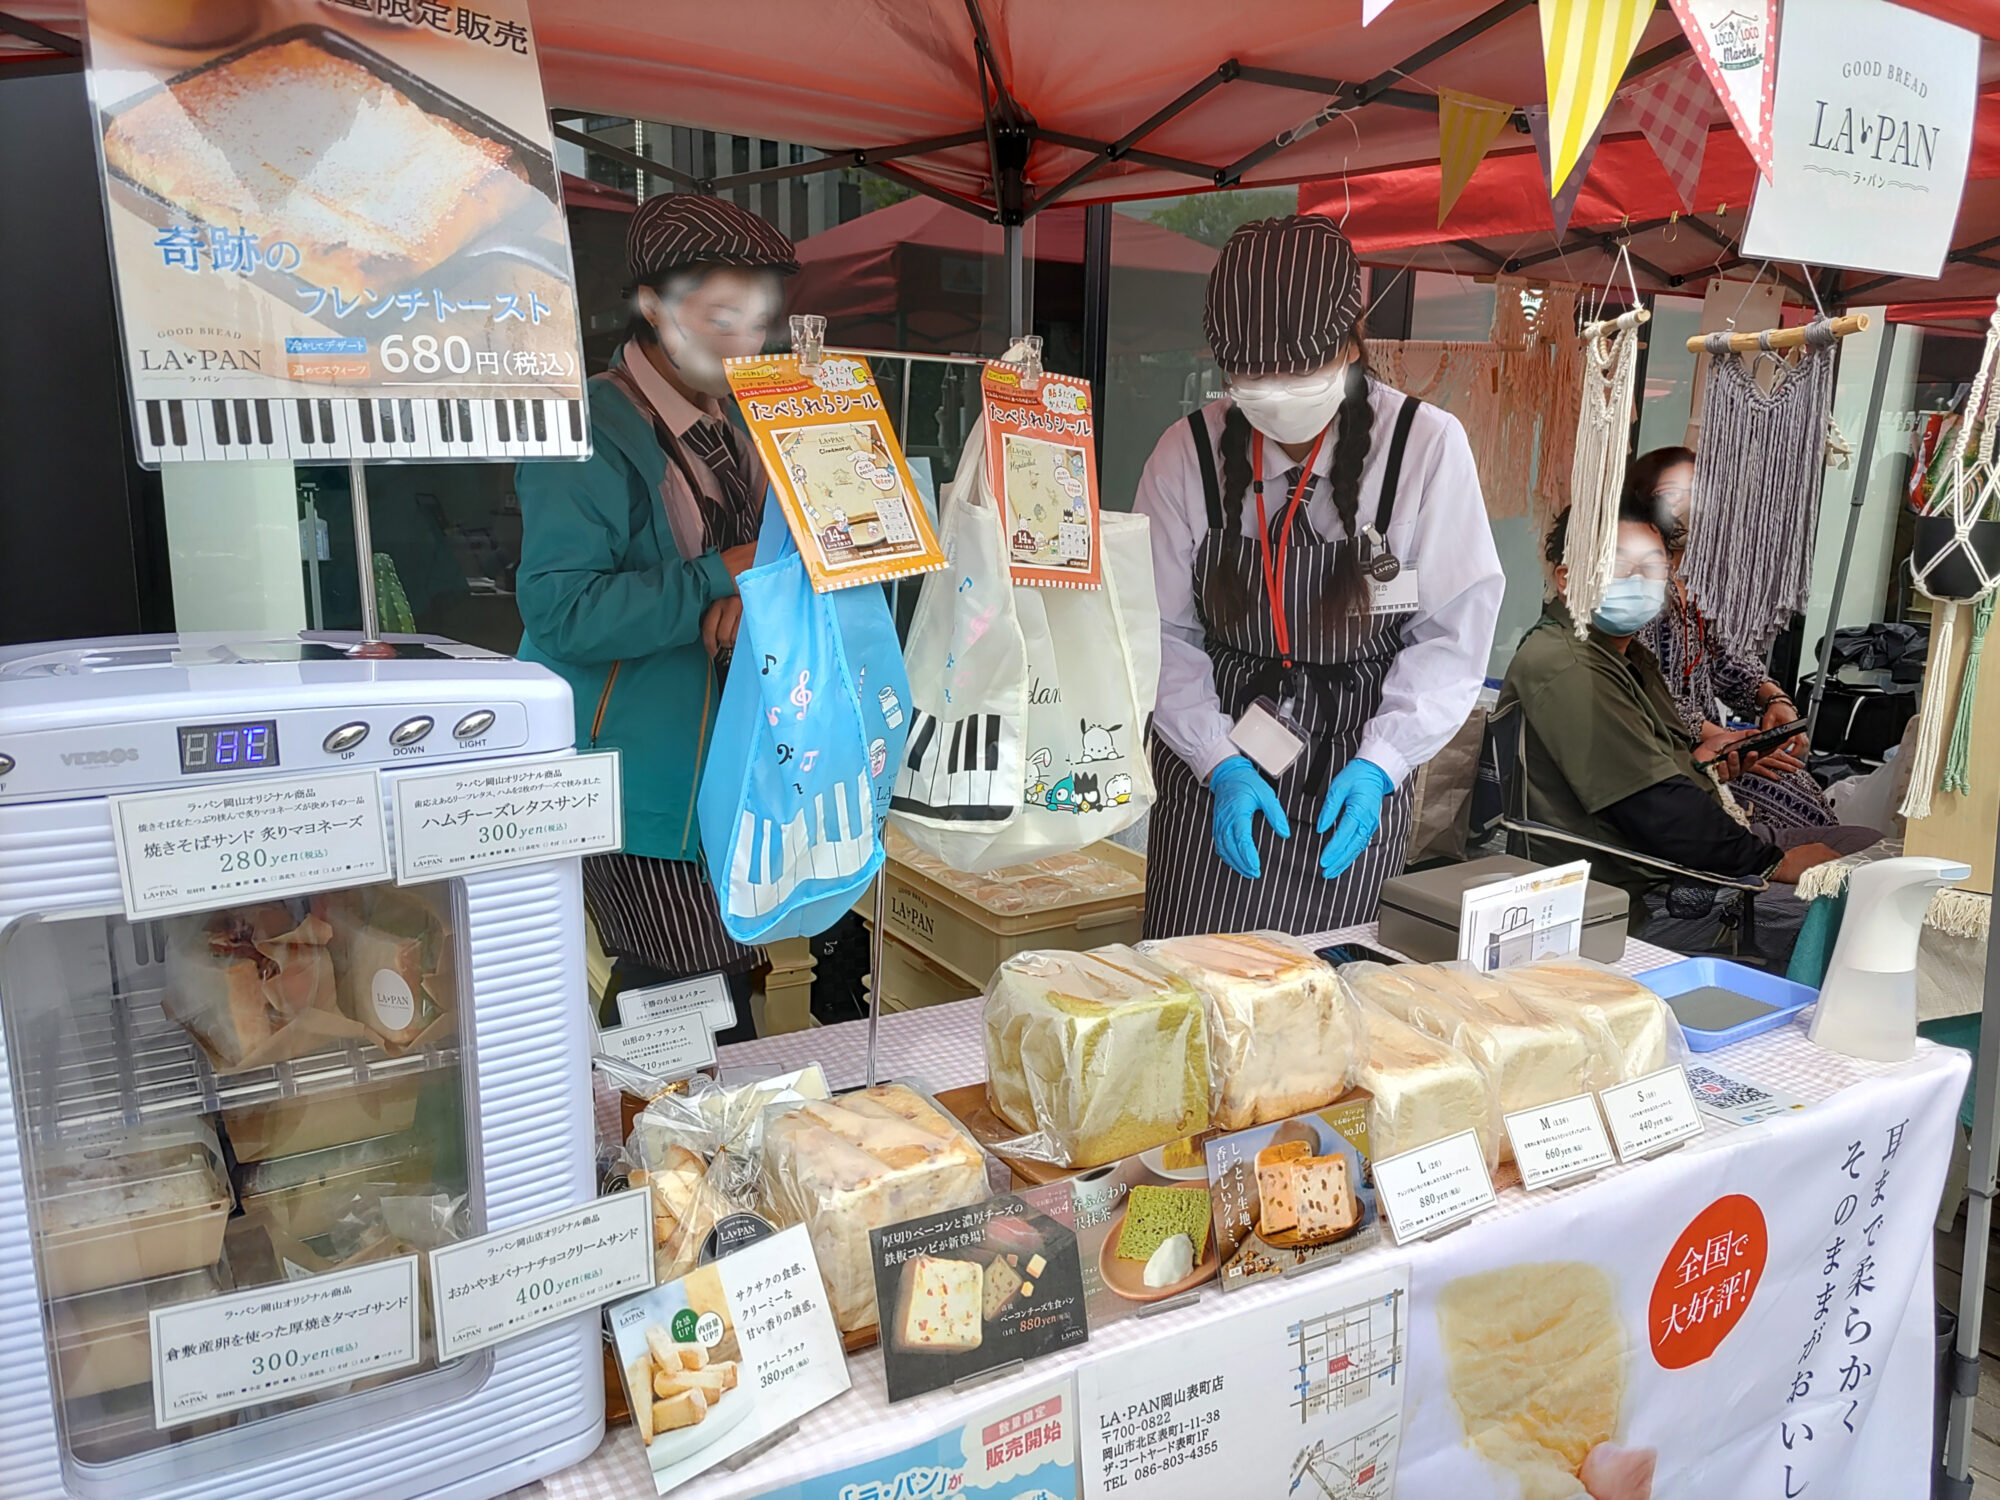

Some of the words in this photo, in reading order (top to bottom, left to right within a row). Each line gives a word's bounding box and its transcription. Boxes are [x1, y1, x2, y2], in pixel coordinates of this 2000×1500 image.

[1842, 60, 1882, 79] GOOD
[1887, 64, 1929, 99] BREAD
[154, 227, 301, 275] 奇跡の
[295, 286, 551, 324] フレンチトースト
[157, 328, 194, 339] GOOD
[199, 327, 242, 340] BREAD
[750, 394, 879, 421] たべられるシール
[989, 402, 1091, 436] たべられるシール
[61, 748, 139, 766] VERSOS
[341, 752, 355, 760] UP
[393, 746, 425, 756] DOWN
[459, 739, 487, 749] LIGHT
[456, 769, 562, 791] ラ・パン岡山オリジナル商品
[187, 788, 316, 812] ラ・パン岡山オリジナル商品
[421, 792, 599, 829] ハムチーズレタスサンド
[144, 829, 255, 858] 焼きそばサンド
[261, 815, 364, 842] 炙りマヨネーズ
[622, 1024, 686, 1047] 山形のラ・フランス
[1637, 1090, 1645, 1102] S
[1540, 1117, 1551, 1130] M
[1417, 1161, 1427, 1174] L
[1215, 1146, 1240, 1248] 香ばしいクルミ。
[1231, 1143, 1253, 1231] しっとり生地、
[487, 1214, 600, 1257] ラ・パン岡山店オリジナル商品
[882, 1204, 1023, 1248] 厚切りベーコンと濃厚チーズの
[448, 1228, 639, 1300] おかやまバナナチョコクリームサンド
[884, 1229, 986, 1267] 鉄板コンビが新登場!
[1674, 1230, 1750, 1290] 全国で
[736, 1262, 807, 1302] サクサクの食感、
[1841, 1117, 1910, 1434] 耳まで柔らかく
[224, 1285, 352, 1320] ラ・パン岡山オリジナル商品
[742, 1288, 793, 1321] クリーミーな
[746, 1300, 817, 1341] 甘い香りの誘惑。
[1000, 1296, 1075, 1323] ベーコンチーズ生食パン
[1658, 1269, 1751, 1347] 大好評!
[1781, 1139, 1865, 1499] そのままがおいし
[165, 1296, 409, 1362] 倉敷産卵を使った厚焼きタマゴサンド
[675, 1315, 691, 1330] 食感
[678, 1325, 694, 1339] UP!
[698, 1318, 720, 1335] 内容量
[757, 1341, 806, 1373] クリーミーラスク
[986, 1420, 1062, 1470] 販売開始
[1102, 1412, 1171, 1443] 〒700-0822
[1102, 1409, 1221, 1461] 岡山市北区表町1-11-38
[1103, 1429, 1209, 1477] ザ・コートヤード表町1F
[1104, 1473, 1128, 1492] TEL
[1134, 1440, 1218, 1481] 086-803-4355
